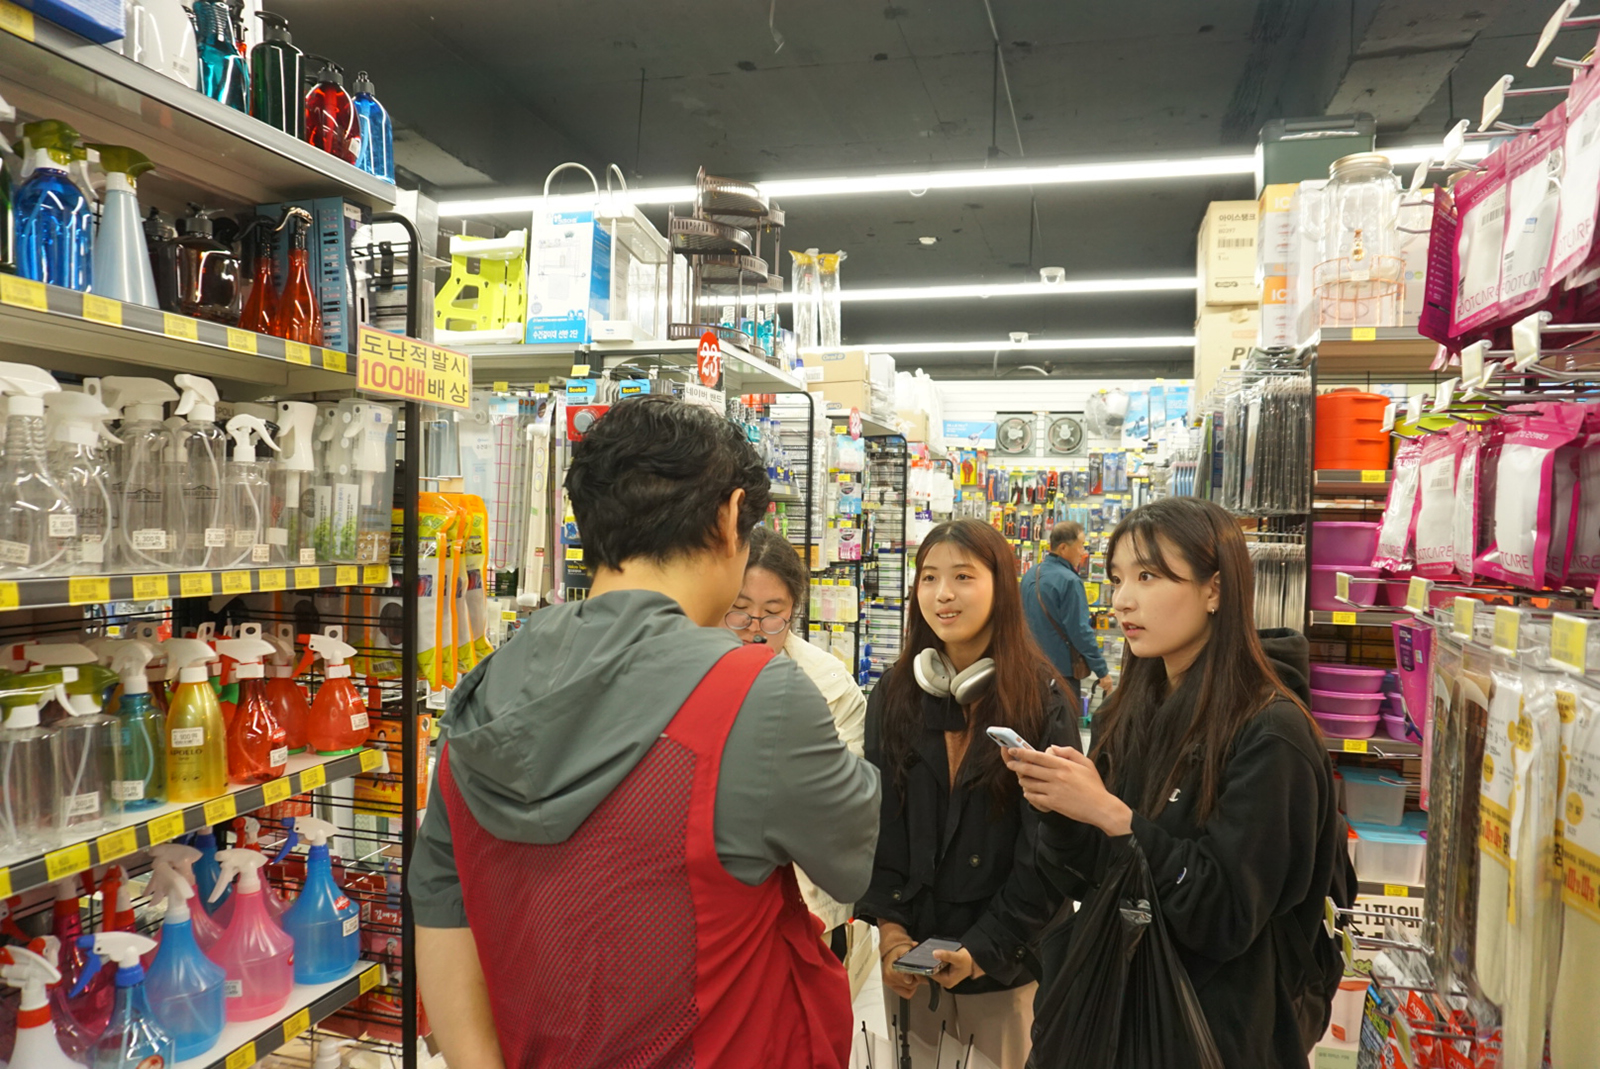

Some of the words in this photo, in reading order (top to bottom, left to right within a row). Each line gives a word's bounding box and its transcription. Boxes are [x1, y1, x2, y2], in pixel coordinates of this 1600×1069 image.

[361, 358, 426, 397] 100배
[427, 378, 468, 404] 배상
[686, 387, 708, 400] 네이버
